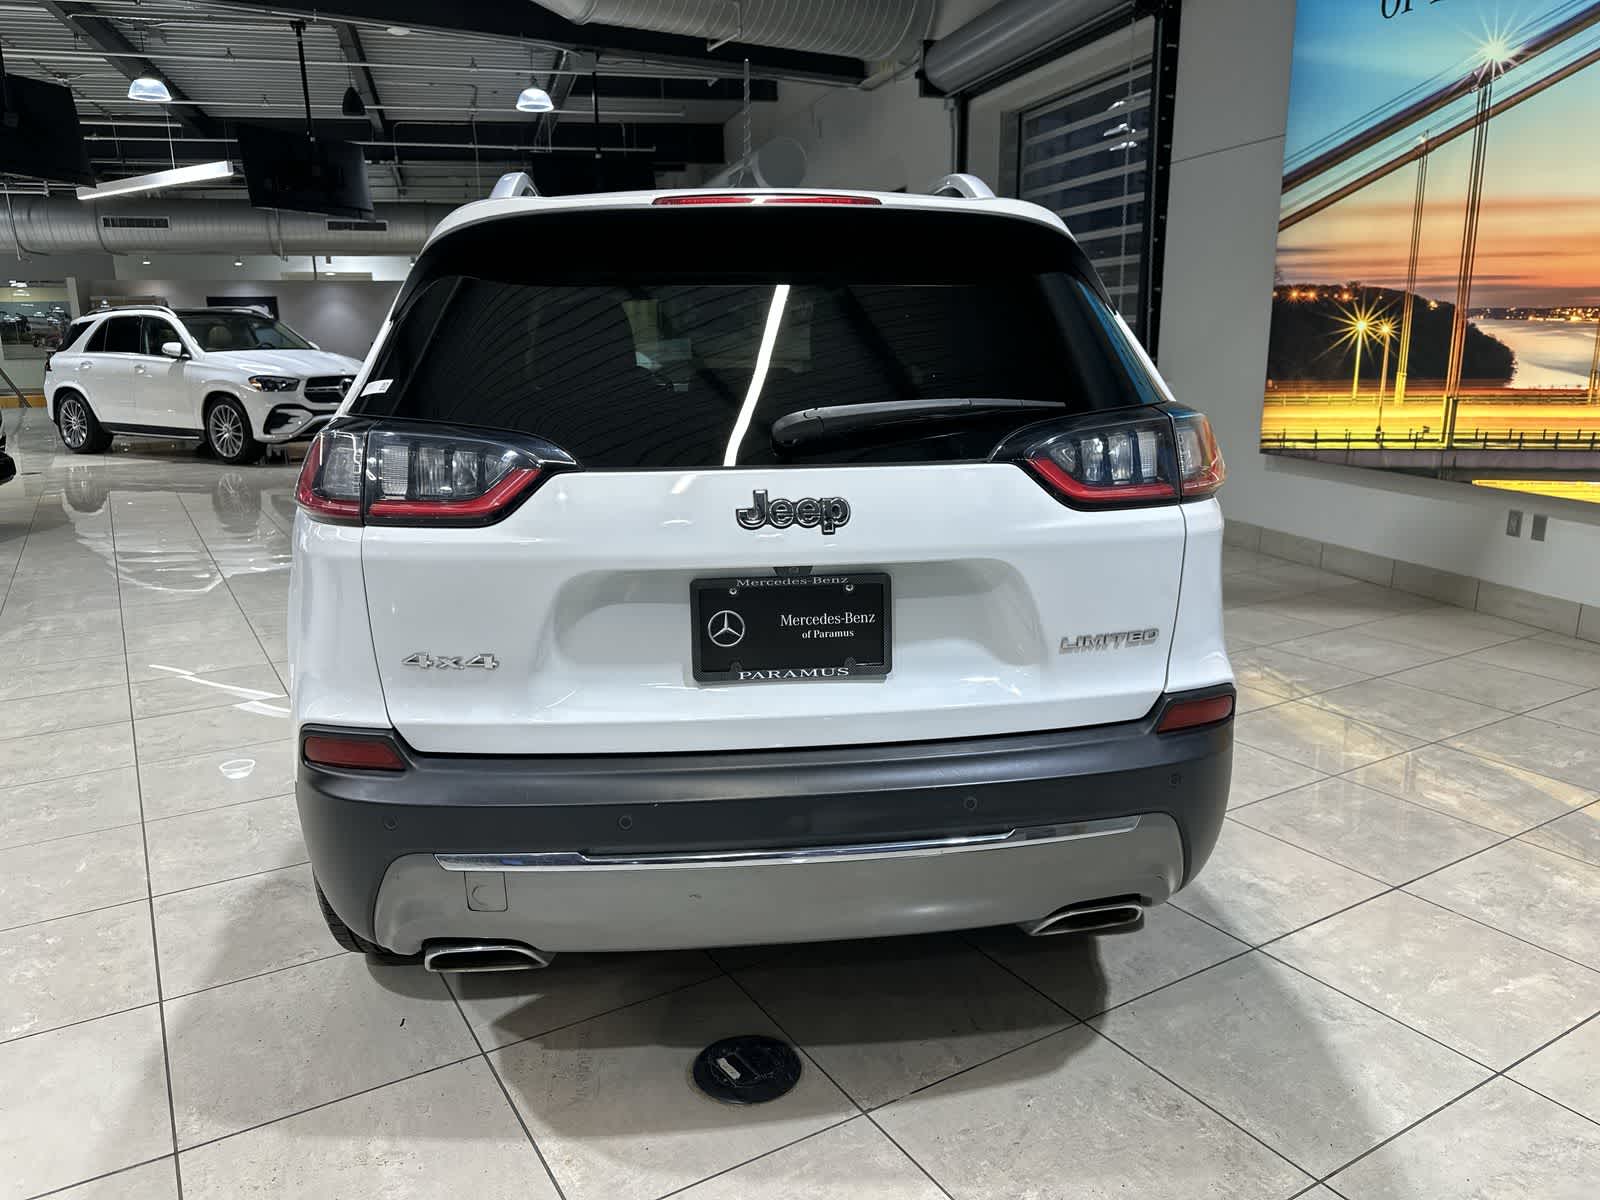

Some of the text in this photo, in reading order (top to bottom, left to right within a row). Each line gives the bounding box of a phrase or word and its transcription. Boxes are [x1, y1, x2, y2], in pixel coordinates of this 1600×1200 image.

[736, 489, 851, 535] Jeep
[735, 576, 849, 587] Mercedes-Benz
[780, 611, 876, 627] Mercedes-Benz
[801, 629, 855, 639] of Paramus
[1060, 628, 1160, 653] LIMITED
[401, 652, 500, 670] 4x4
[737, 667, 850, 681] PARAMUS
